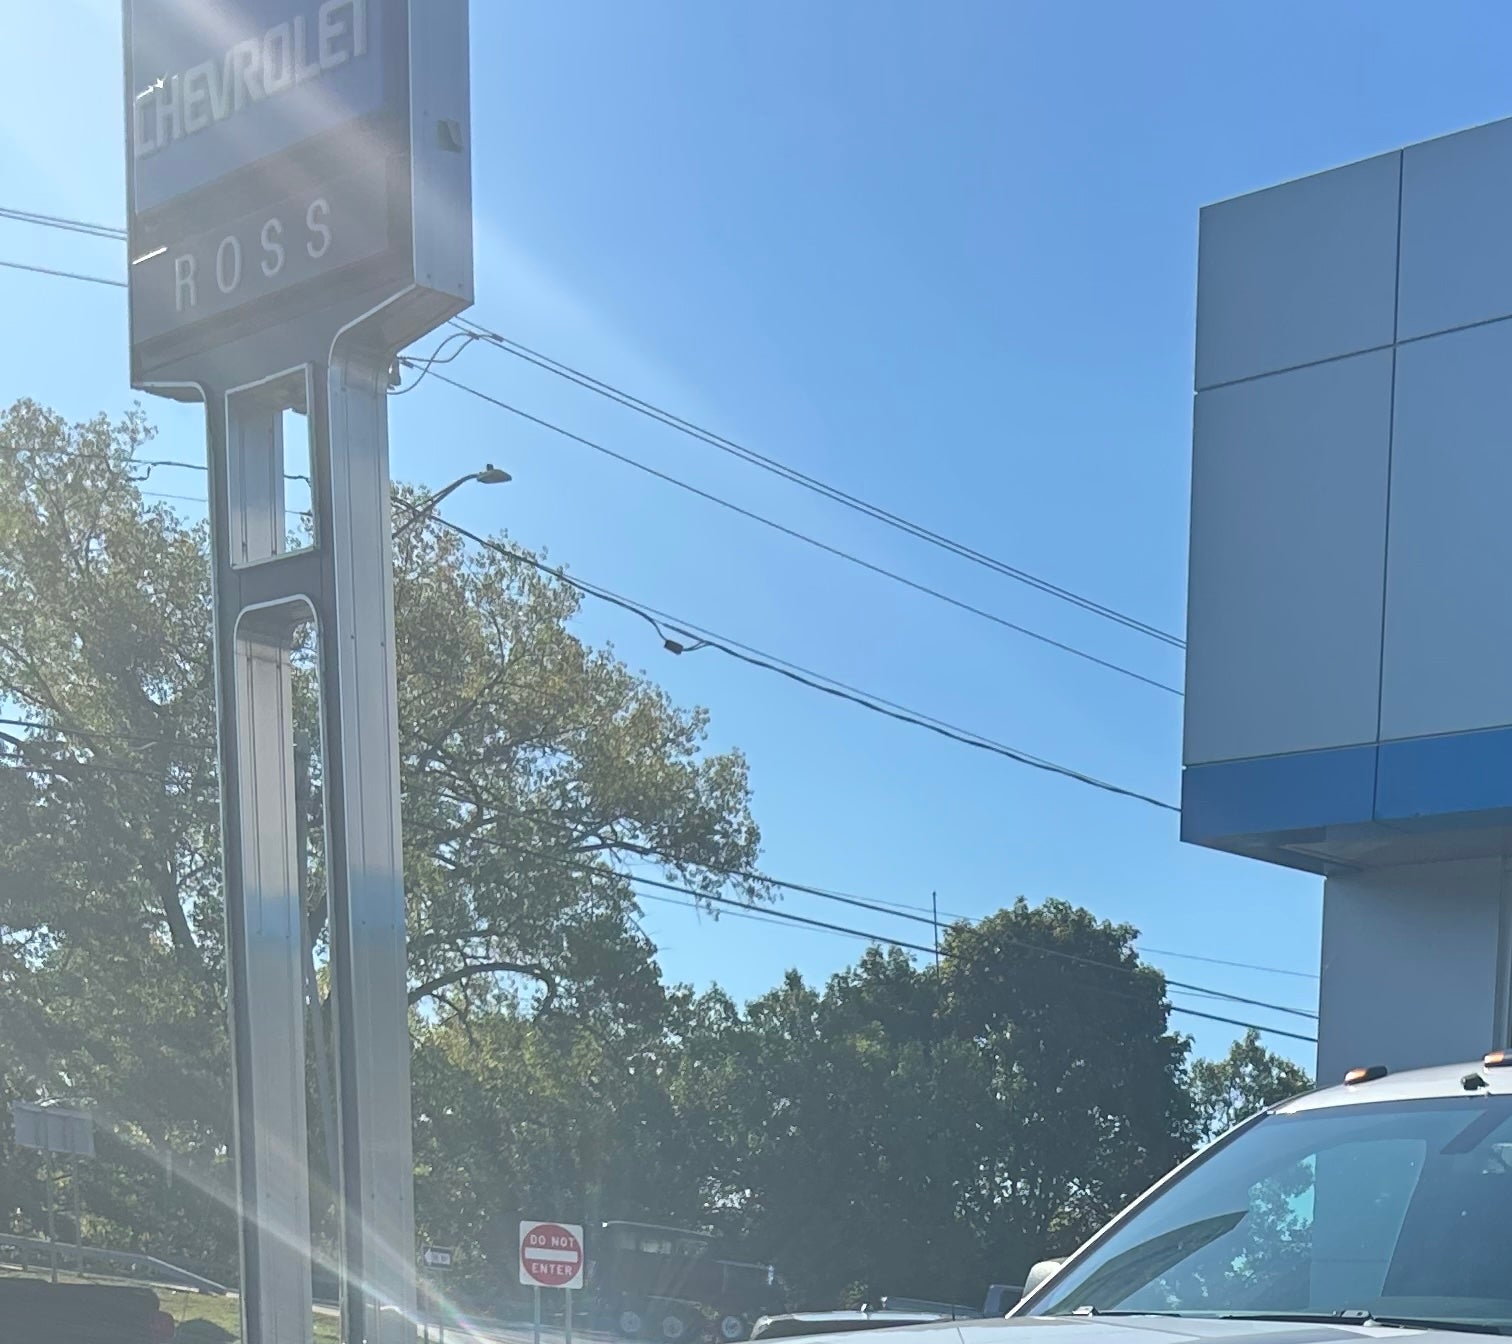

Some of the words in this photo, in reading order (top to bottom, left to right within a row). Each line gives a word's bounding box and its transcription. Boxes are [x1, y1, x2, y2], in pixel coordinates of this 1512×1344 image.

[134, 0, 368, 160] CHEVROLET
[173, 198, 332, 312] ROSS
[530, 1234, 546, 1245] DO
[551, 1236, 575, 1248] NOT
[532, 1263, 573, 1276] ENTER
